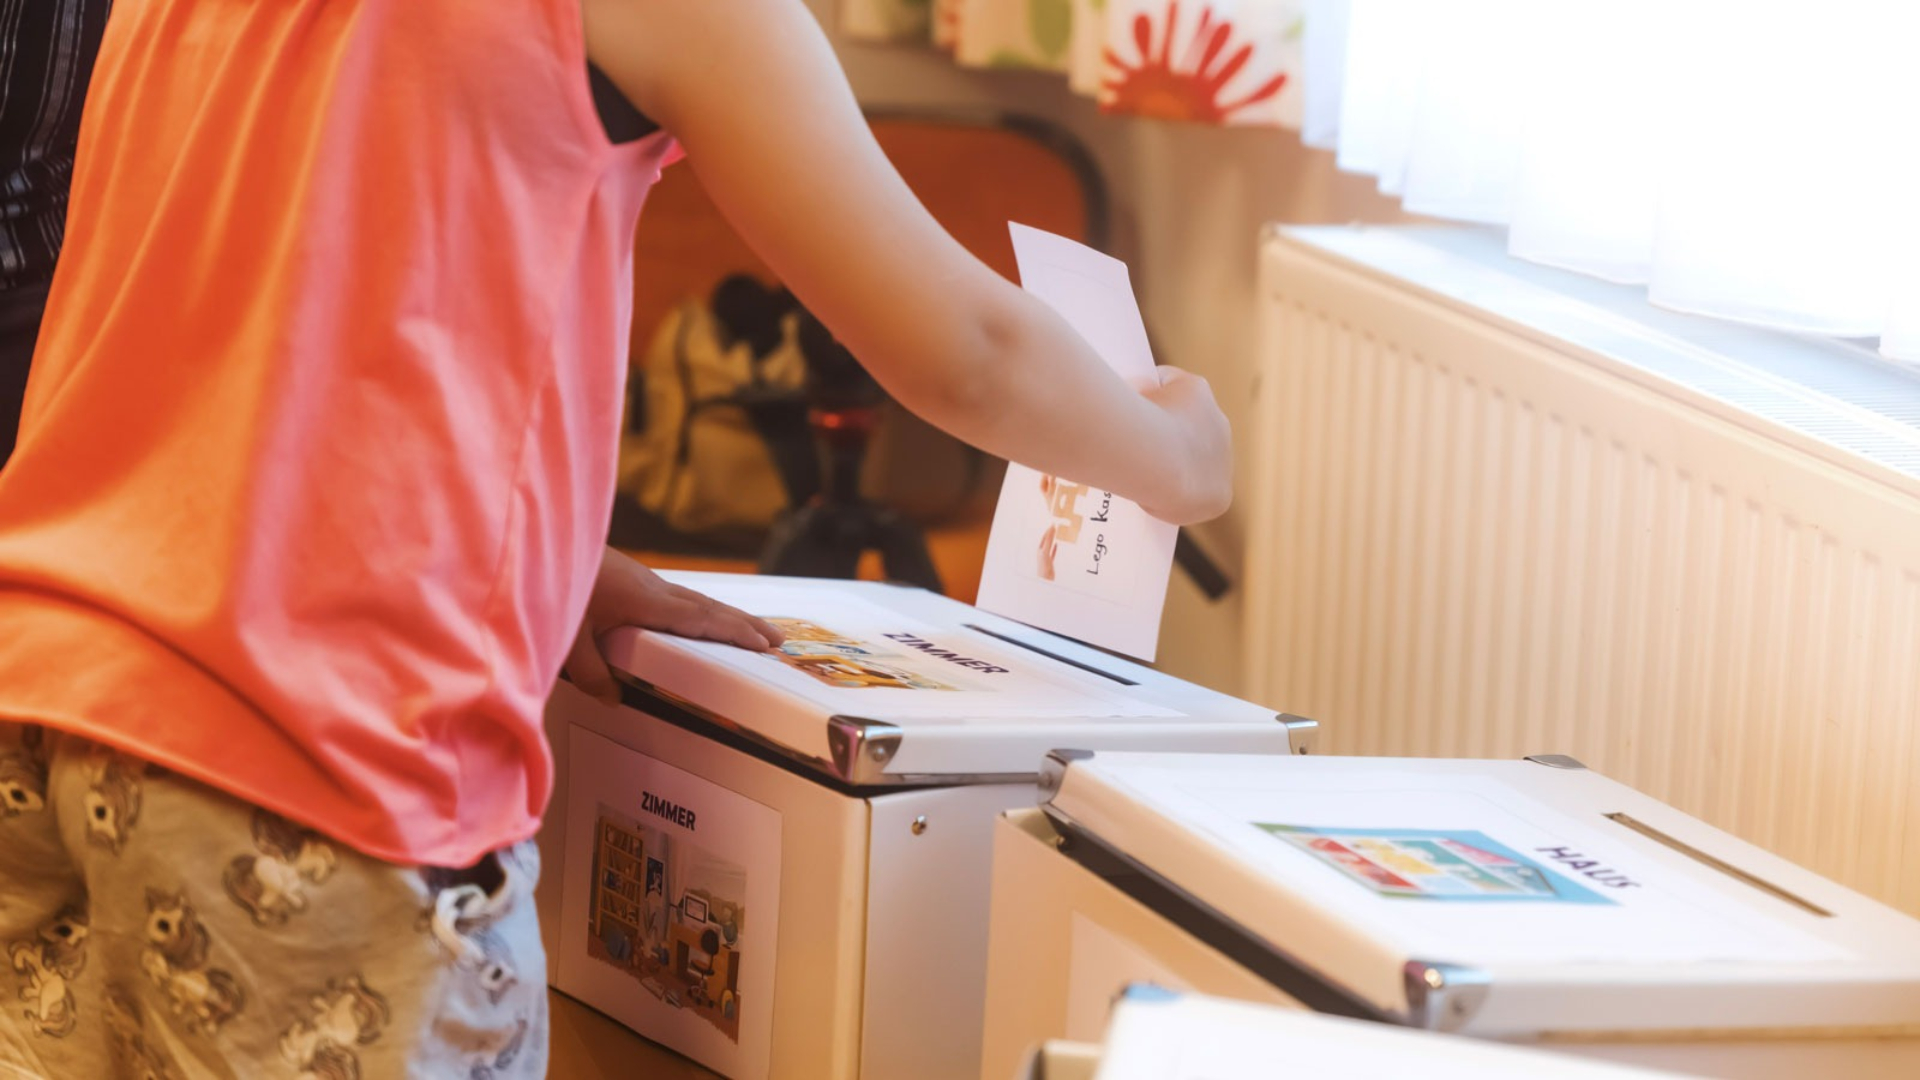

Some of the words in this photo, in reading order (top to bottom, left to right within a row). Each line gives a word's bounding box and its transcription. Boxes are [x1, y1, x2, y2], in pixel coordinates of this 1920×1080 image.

[1087, 533, 1108, 575] Lego
[882, 632, 1010, 674] ZIMMER
[641, 790, 697, 831] ZIMMER
[1535, 846, 1641, 889] HAUS
